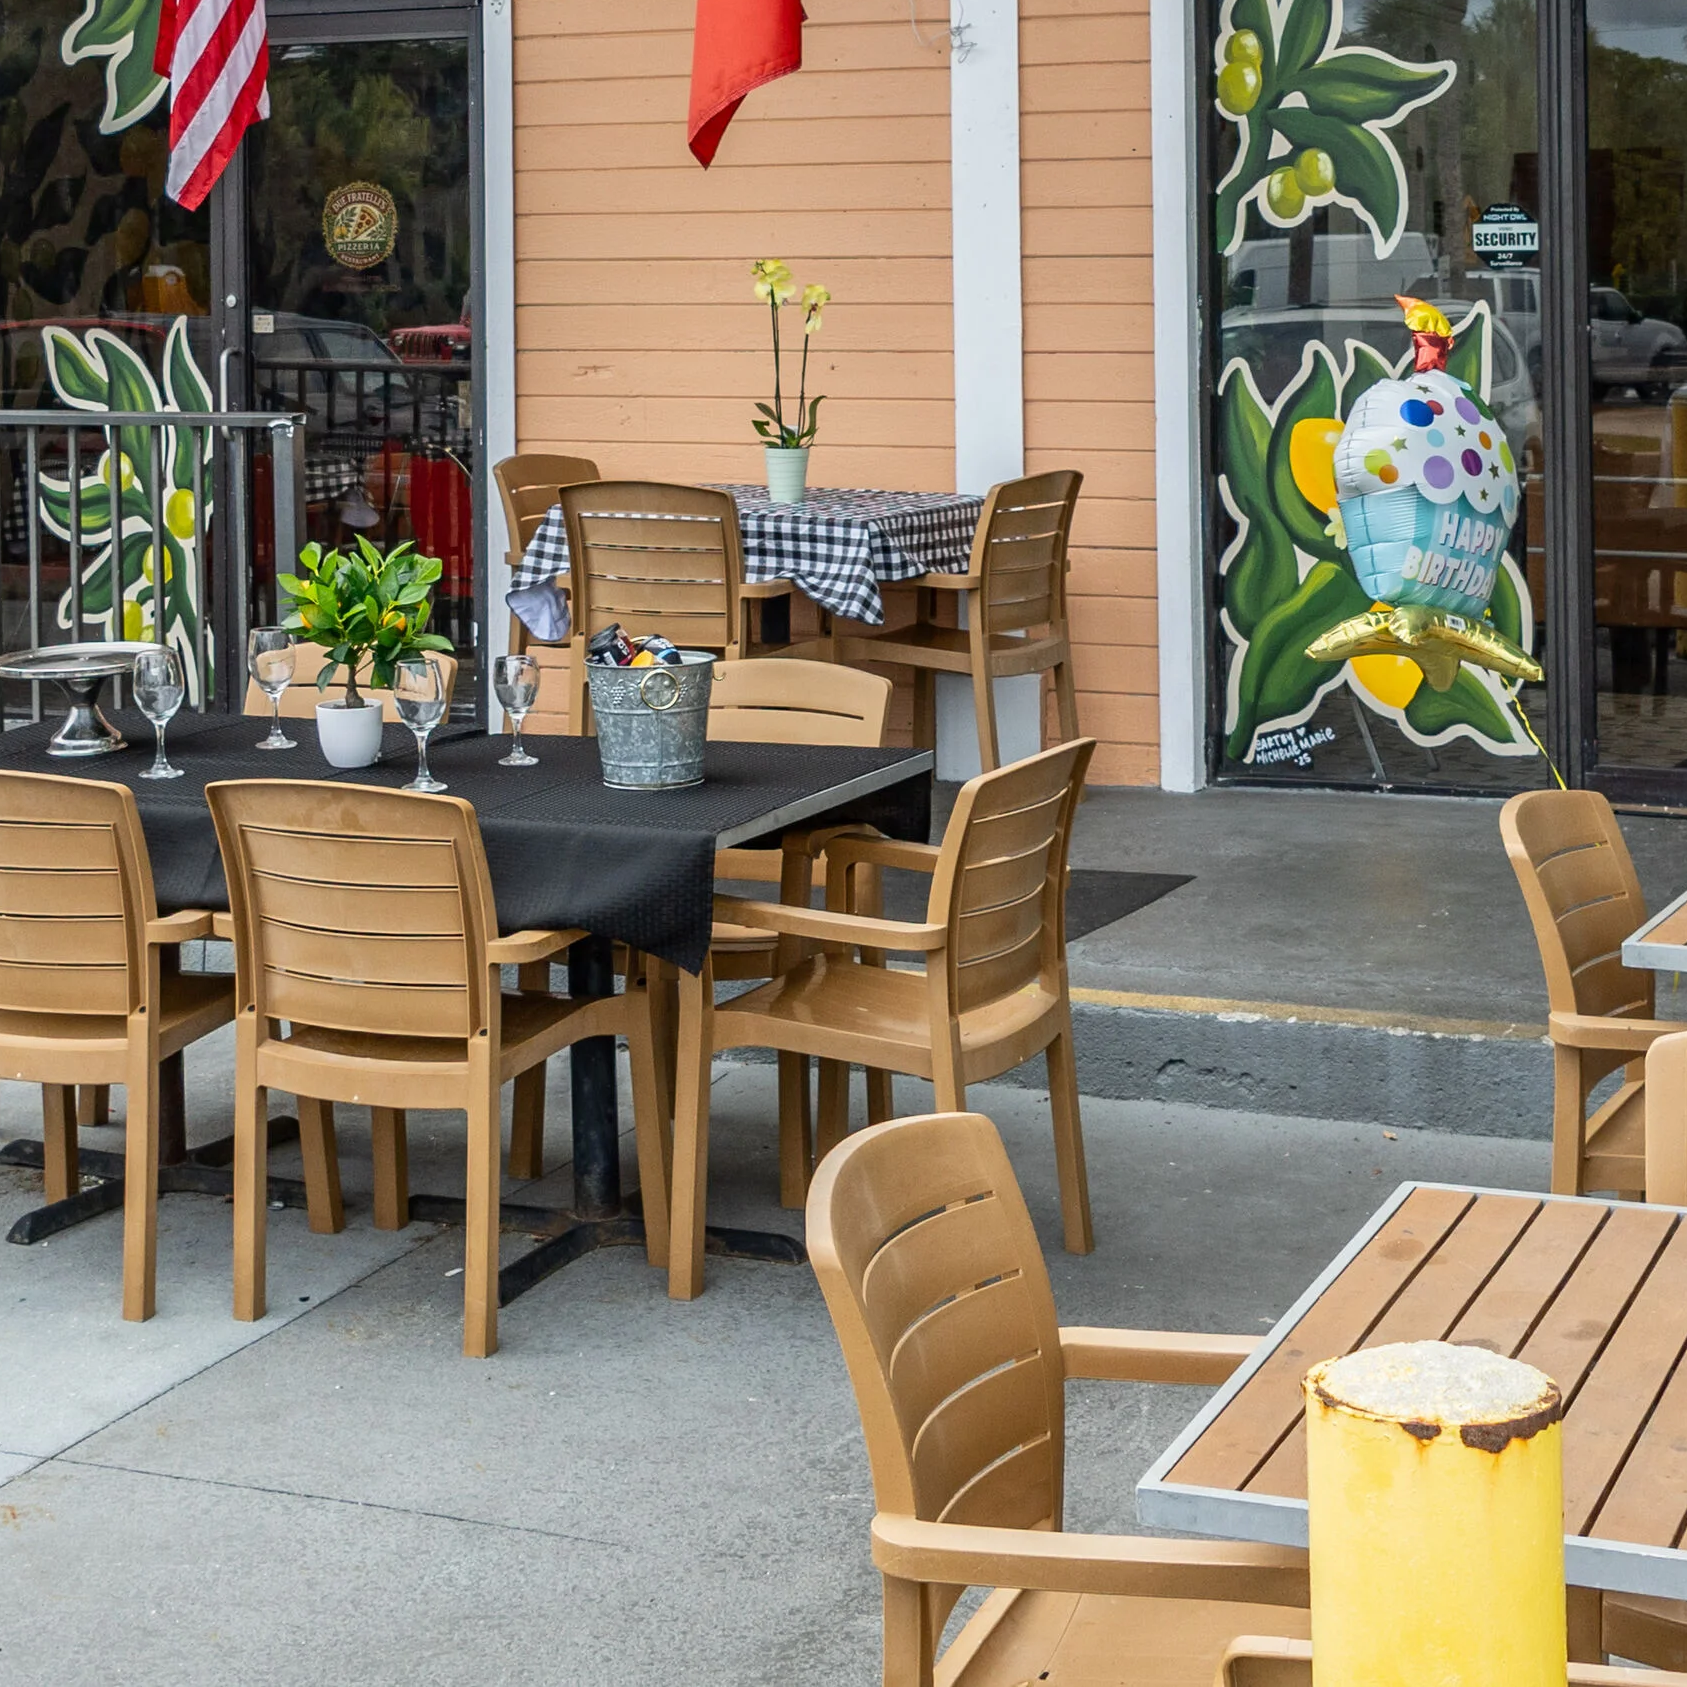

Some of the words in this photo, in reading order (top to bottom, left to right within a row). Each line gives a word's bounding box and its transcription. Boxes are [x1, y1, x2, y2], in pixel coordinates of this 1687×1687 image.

[337, 242, 380, 251] PIZZERIA
[1475, 232, 1536, 246] SECURITY
[1438, 511, 1504, 562] HAPPY
[1400, 545, 1496, 600] BIRTHDA
